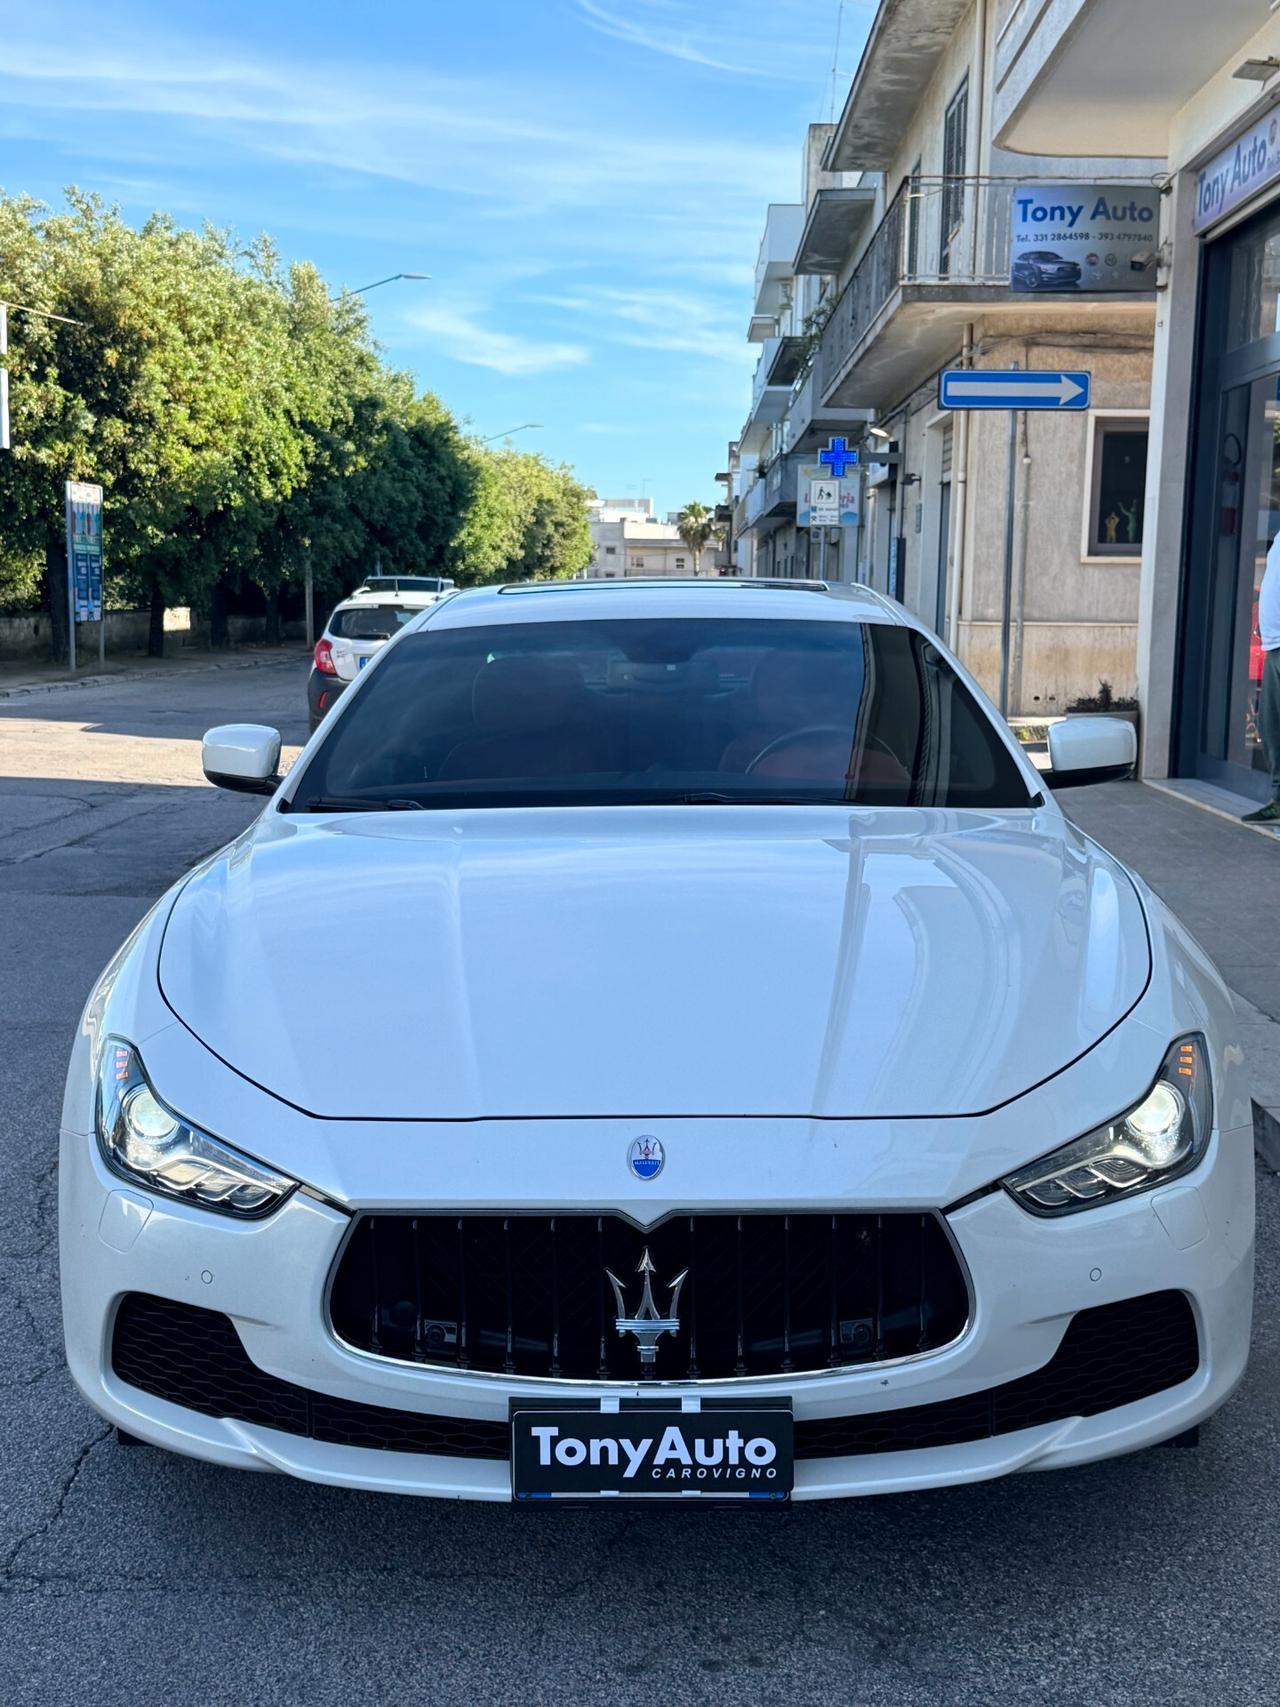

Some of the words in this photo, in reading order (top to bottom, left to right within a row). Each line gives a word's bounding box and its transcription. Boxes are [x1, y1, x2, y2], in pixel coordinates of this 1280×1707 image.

[1198, 170, 1229, 217] Tony
[1231, 136, 1267, 193] Auto
[1017, 198, 1084, 227] Tony
[1090, 196, 1154, 222] Auto
[1016, 234, 1031, 243] Tel.
[1033, 233, 1048, 242] 331
[1050, 232, 1090, 241] 2864598
[531, 1426, 777, 1478] TonyAuto
[651, 1467, 777, 1479] CAROVIGNO
